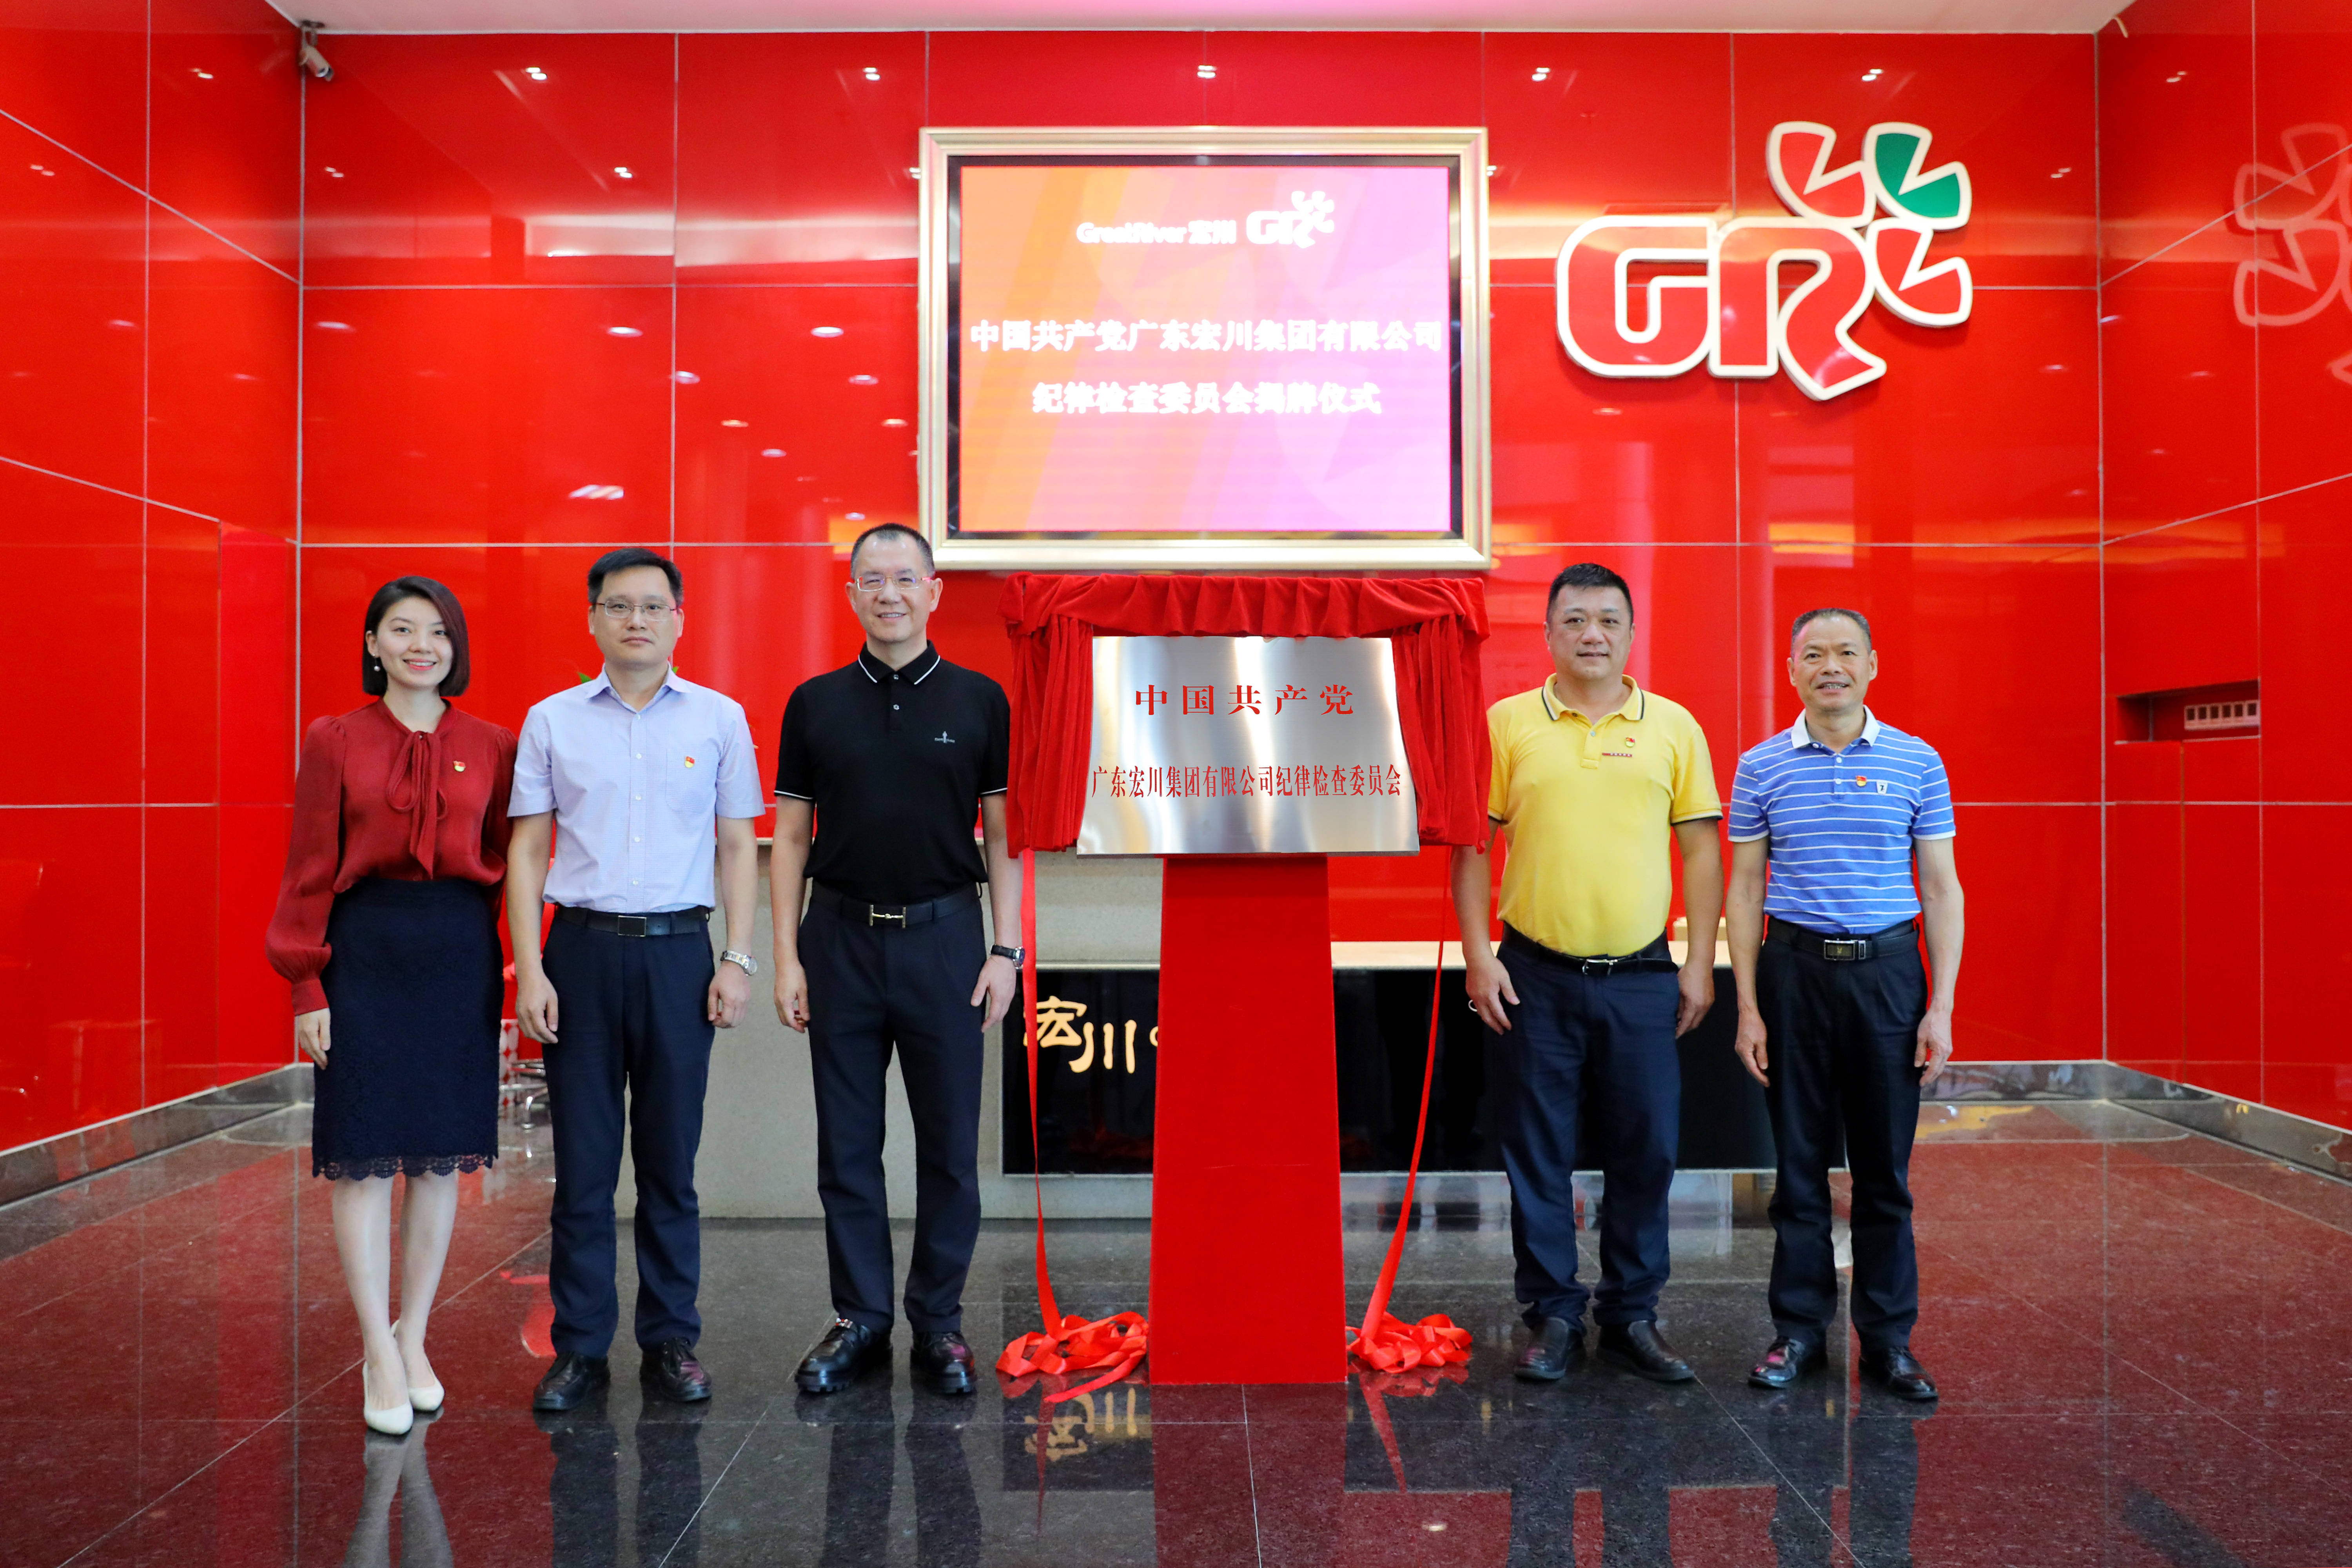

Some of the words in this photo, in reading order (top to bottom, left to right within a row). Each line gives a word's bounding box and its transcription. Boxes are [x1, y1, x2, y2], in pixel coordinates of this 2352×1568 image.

[971, 319, 1442, 352] 中国共产党广东宏川集团有限公司
[1032, 381, 1382, 415] 纪律检查委员会揭牌仪式
[1135, 684, 1354, 716] 中国共产党
[1092, 764, 1401, 798] 广东宏川集团有限公司纪律检查委员会
